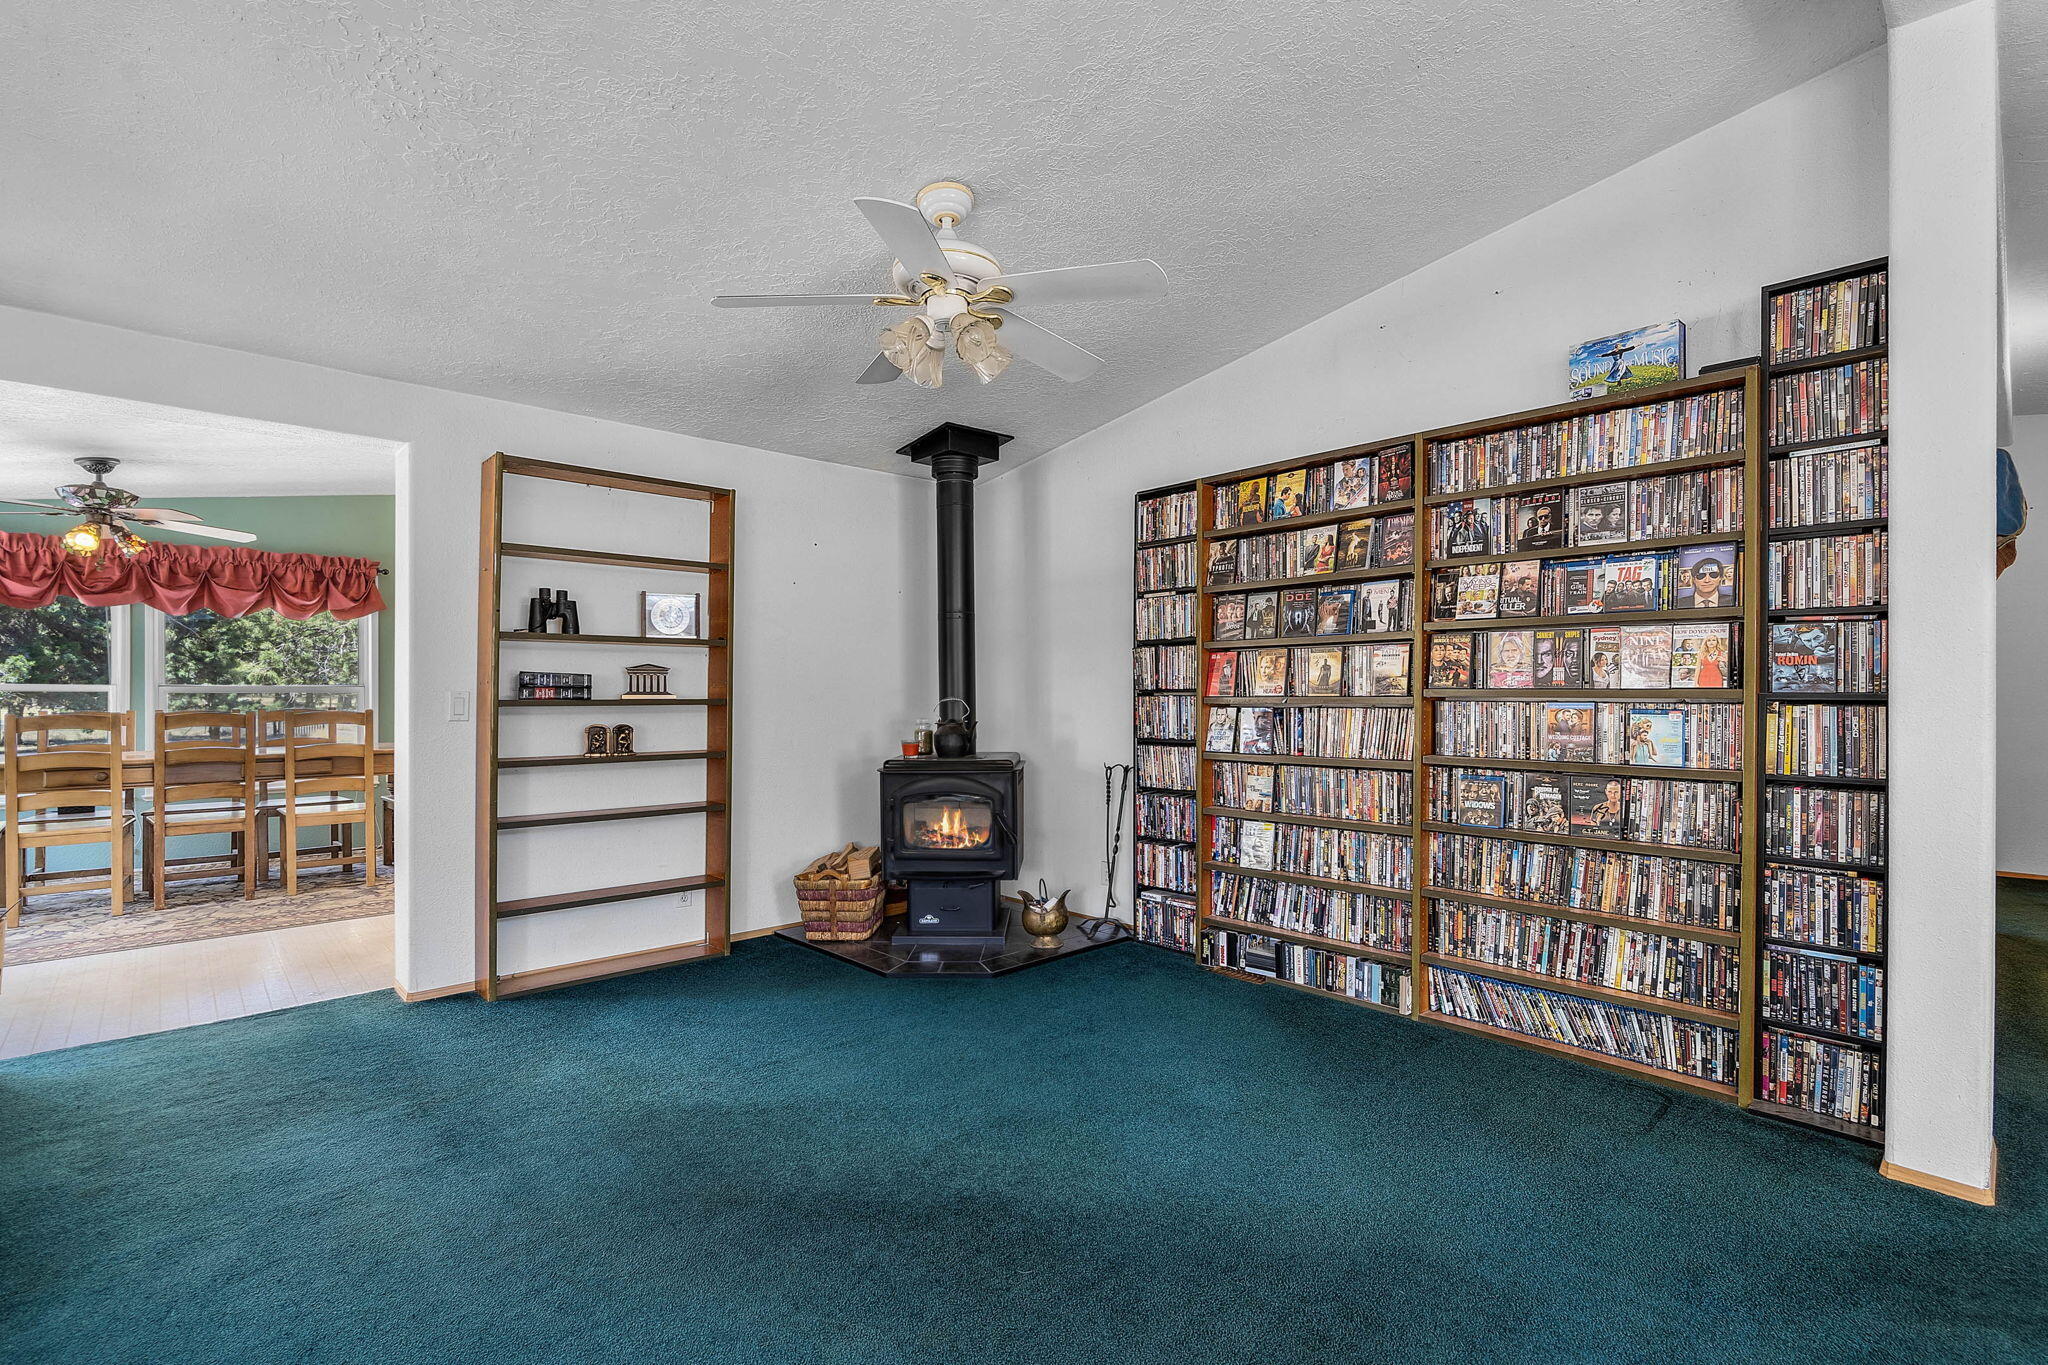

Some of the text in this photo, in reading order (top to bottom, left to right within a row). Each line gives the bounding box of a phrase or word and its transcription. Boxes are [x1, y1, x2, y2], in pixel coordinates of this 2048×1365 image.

[1570, 347, 1677, 390] SOUND MUSIC
[1452, 543, 1484, 554] INDEPENDENT
[1617, 566, 1645, 582] TAG
[1286, 592, 1312, 602] DOE
[1629, 636, 1665, 646] NINE
[1777, 655, 1818, 666] RONIN
[1464, 801, 1496, 810] WIDOWS
